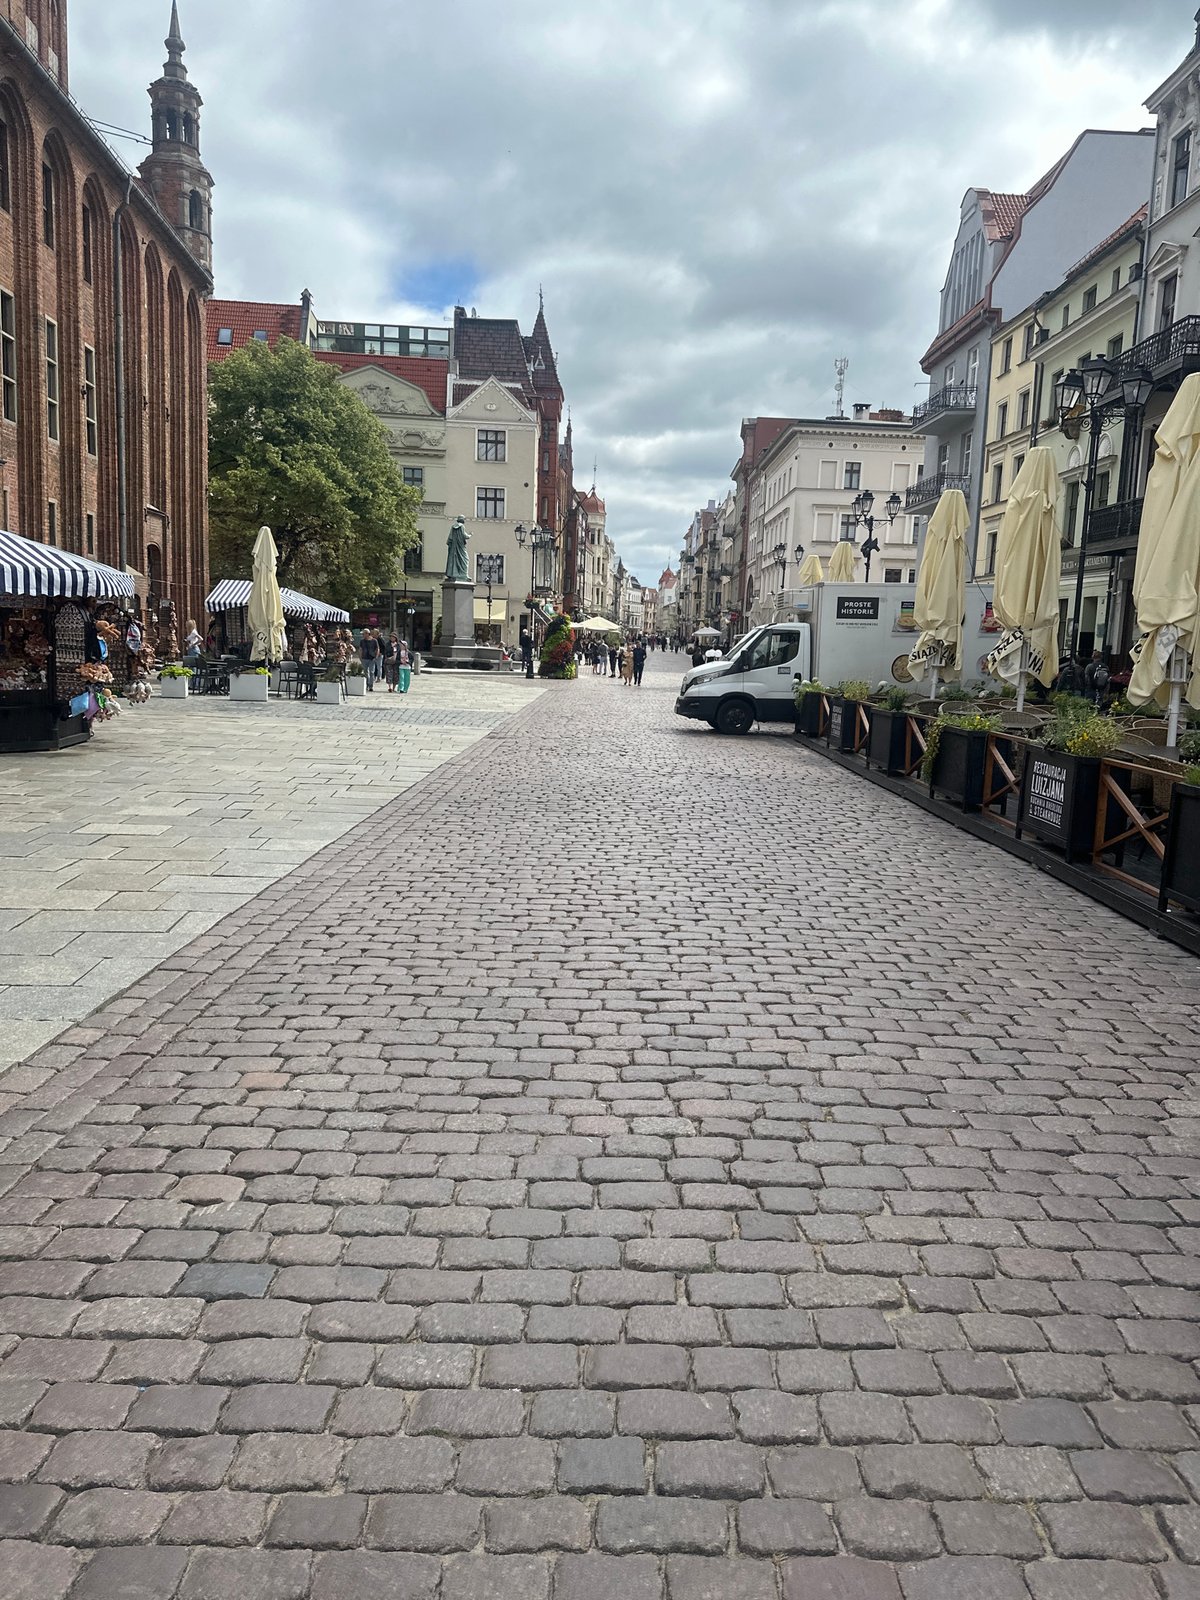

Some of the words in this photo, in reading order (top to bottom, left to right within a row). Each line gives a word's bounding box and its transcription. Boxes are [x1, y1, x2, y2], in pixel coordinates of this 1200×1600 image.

[1033, 761, 1066, 782] RESTAURACJA
[1031, 774, 1065, 802] LUIZJANA
[1034, 805, 1061, 825] STEAKHOUSE
